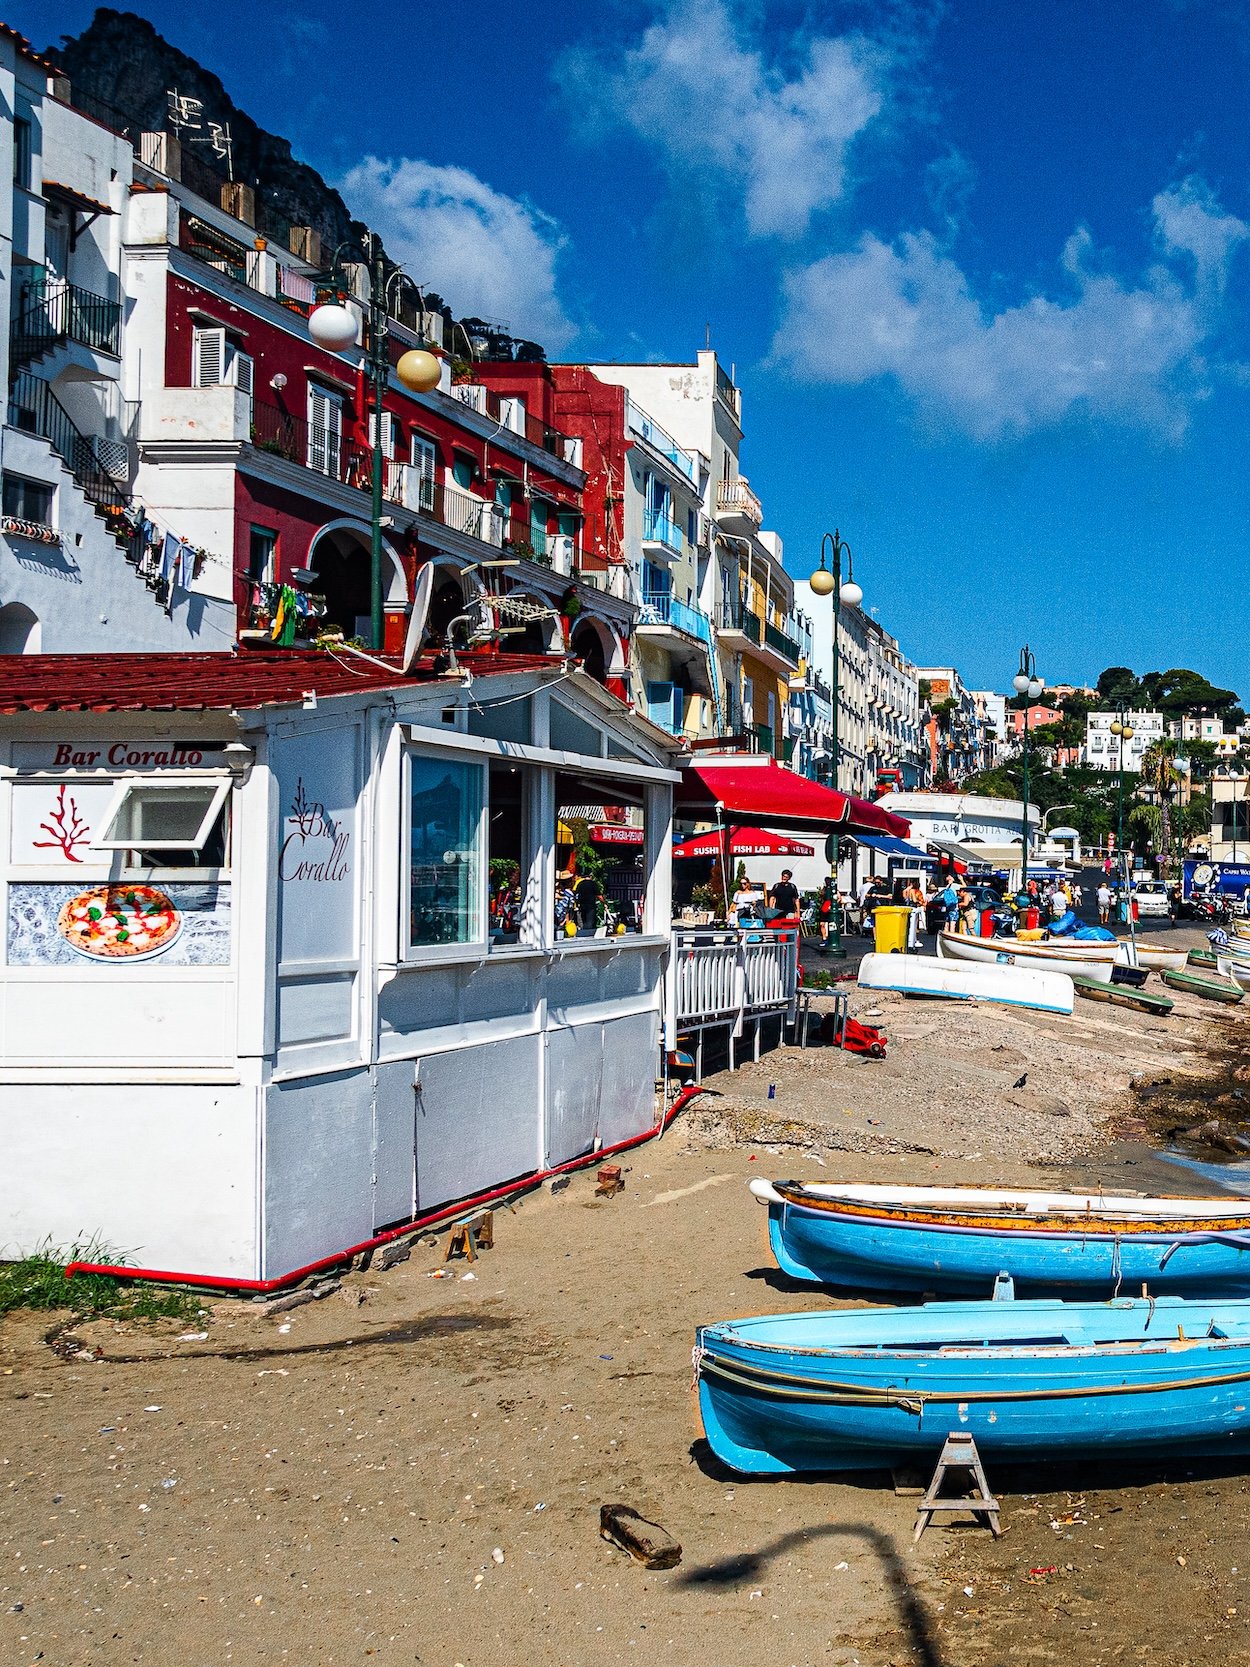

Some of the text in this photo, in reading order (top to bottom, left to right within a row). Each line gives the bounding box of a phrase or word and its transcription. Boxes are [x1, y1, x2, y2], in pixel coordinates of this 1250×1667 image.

[53, 743, 203, 766] Bar Corallo
[307, 802, 342, 839] Bar
[933, 824, 956, 833] BAR
[966, 824, 1001, 835] GROTTA
[279, 832, 351, 882] Corallo
[693, 845, 771, 855] SUSHI FISH LAB
